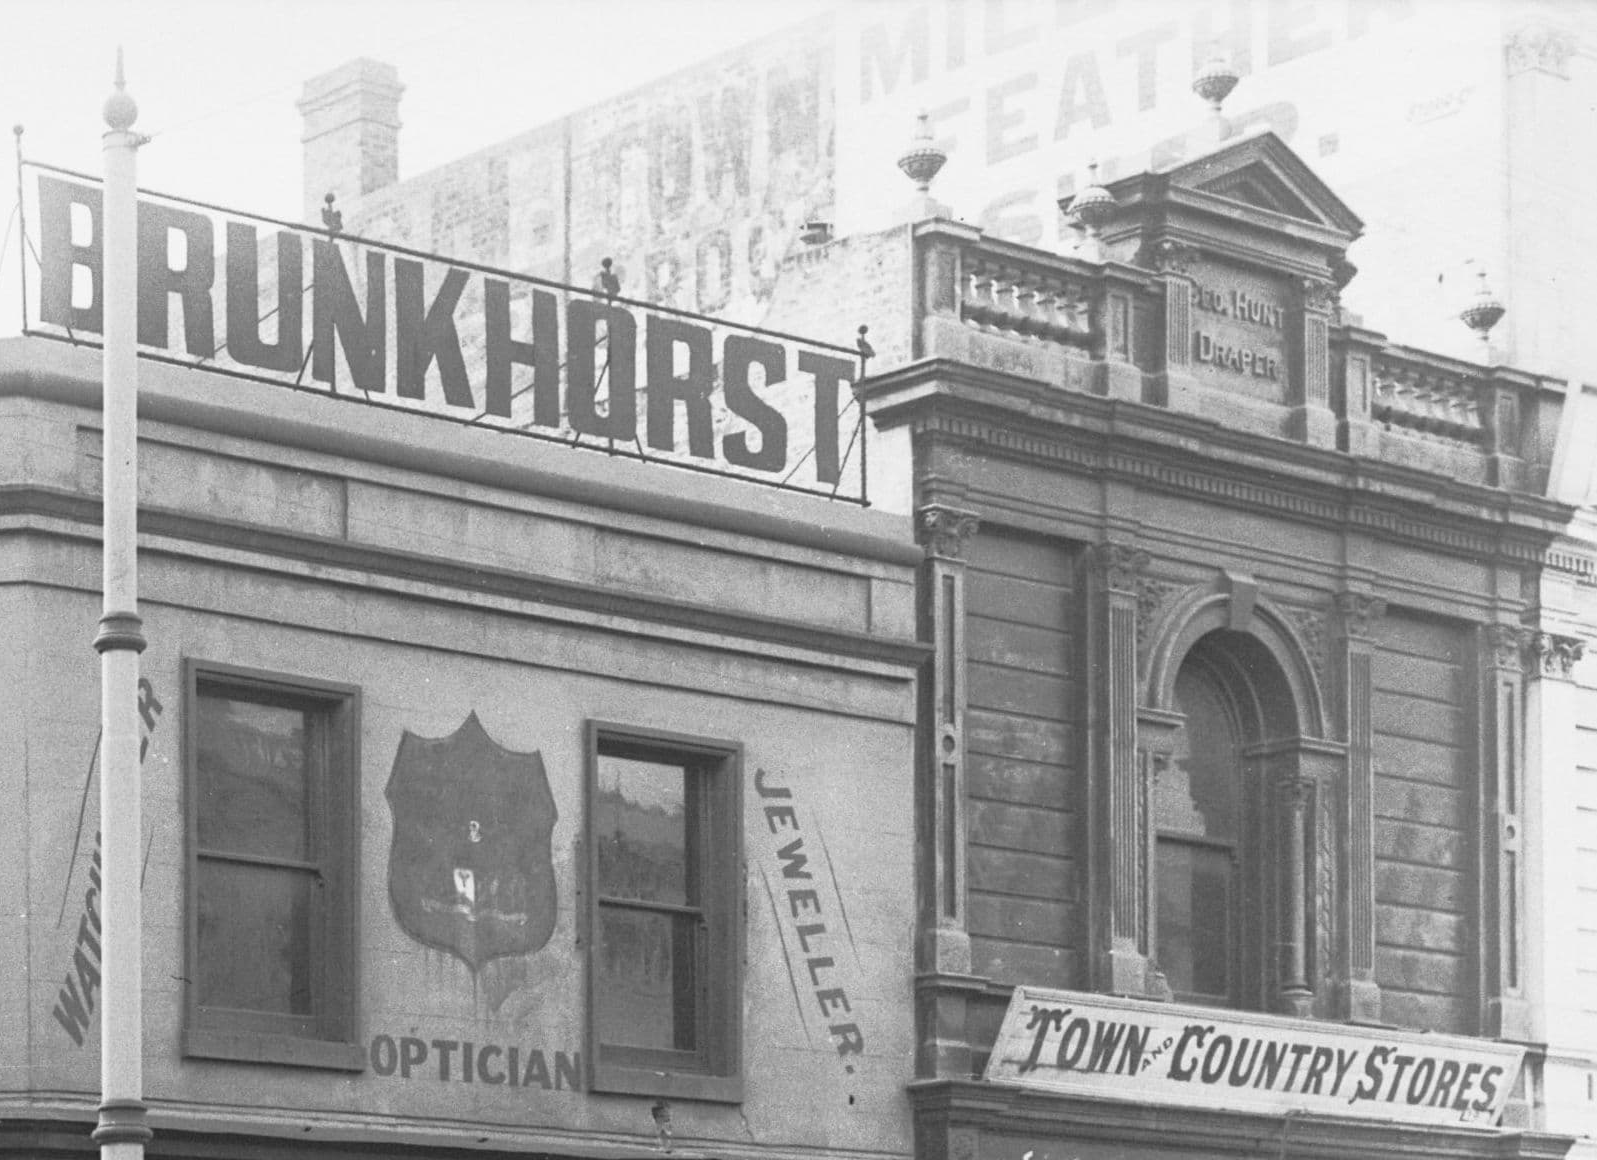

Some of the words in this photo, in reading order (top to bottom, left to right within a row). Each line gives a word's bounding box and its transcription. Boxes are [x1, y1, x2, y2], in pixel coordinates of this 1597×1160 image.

[37, 174, 861, 485] BRUNKHORST
[369, 1032, 582, 1095] OPTICIAN
[1019, 1005, 1152, 1077] TOWN
[1140, 1036, 1174, 1072] AND
[1167, 1025, 1359, 1097] COUNTRY
[1348, 1045, 1504, 1113] STORES
